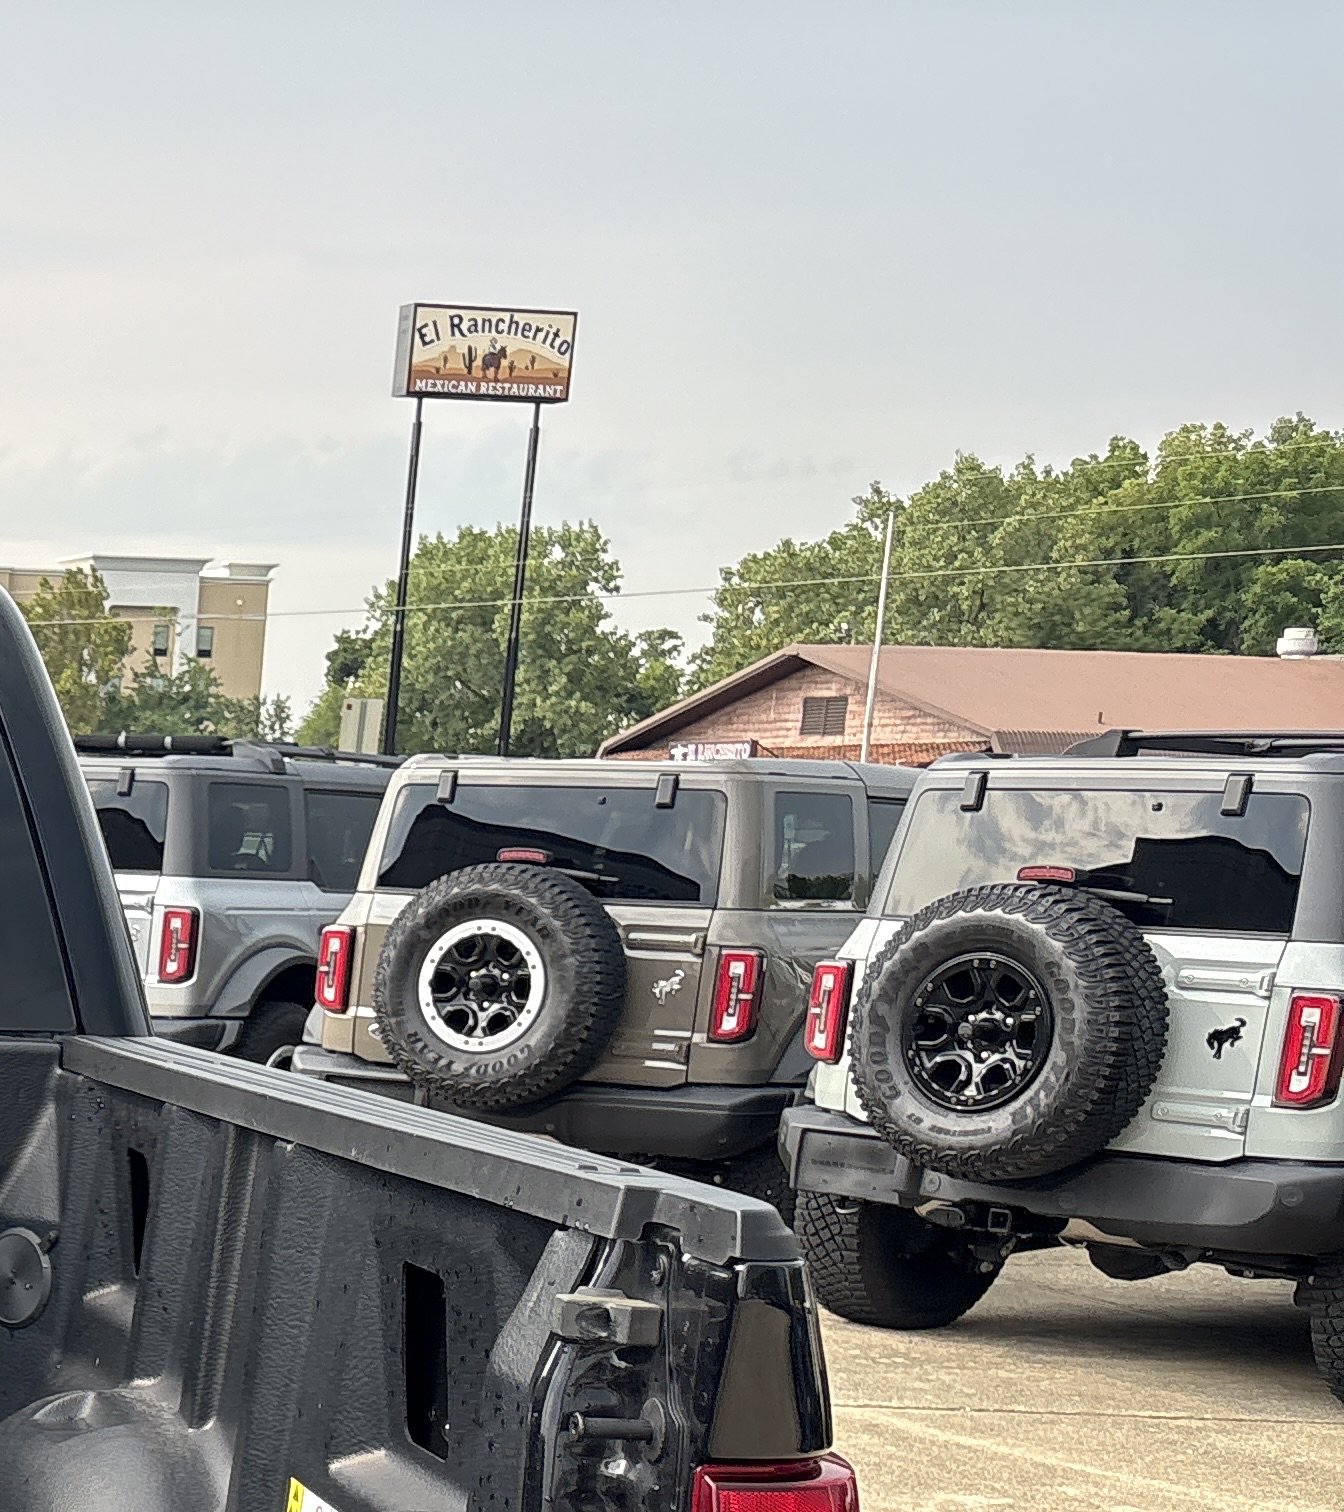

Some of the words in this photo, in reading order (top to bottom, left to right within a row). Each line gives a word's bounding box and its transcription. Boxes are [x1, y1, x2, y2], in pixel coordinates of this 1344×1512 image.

[416, 319, 441, 348] El
[448, 313, 572, 358] Rancherito
[414, 378, 477, 394] MEXICAN
[480, 382, 564, 398] RESTAURANT
